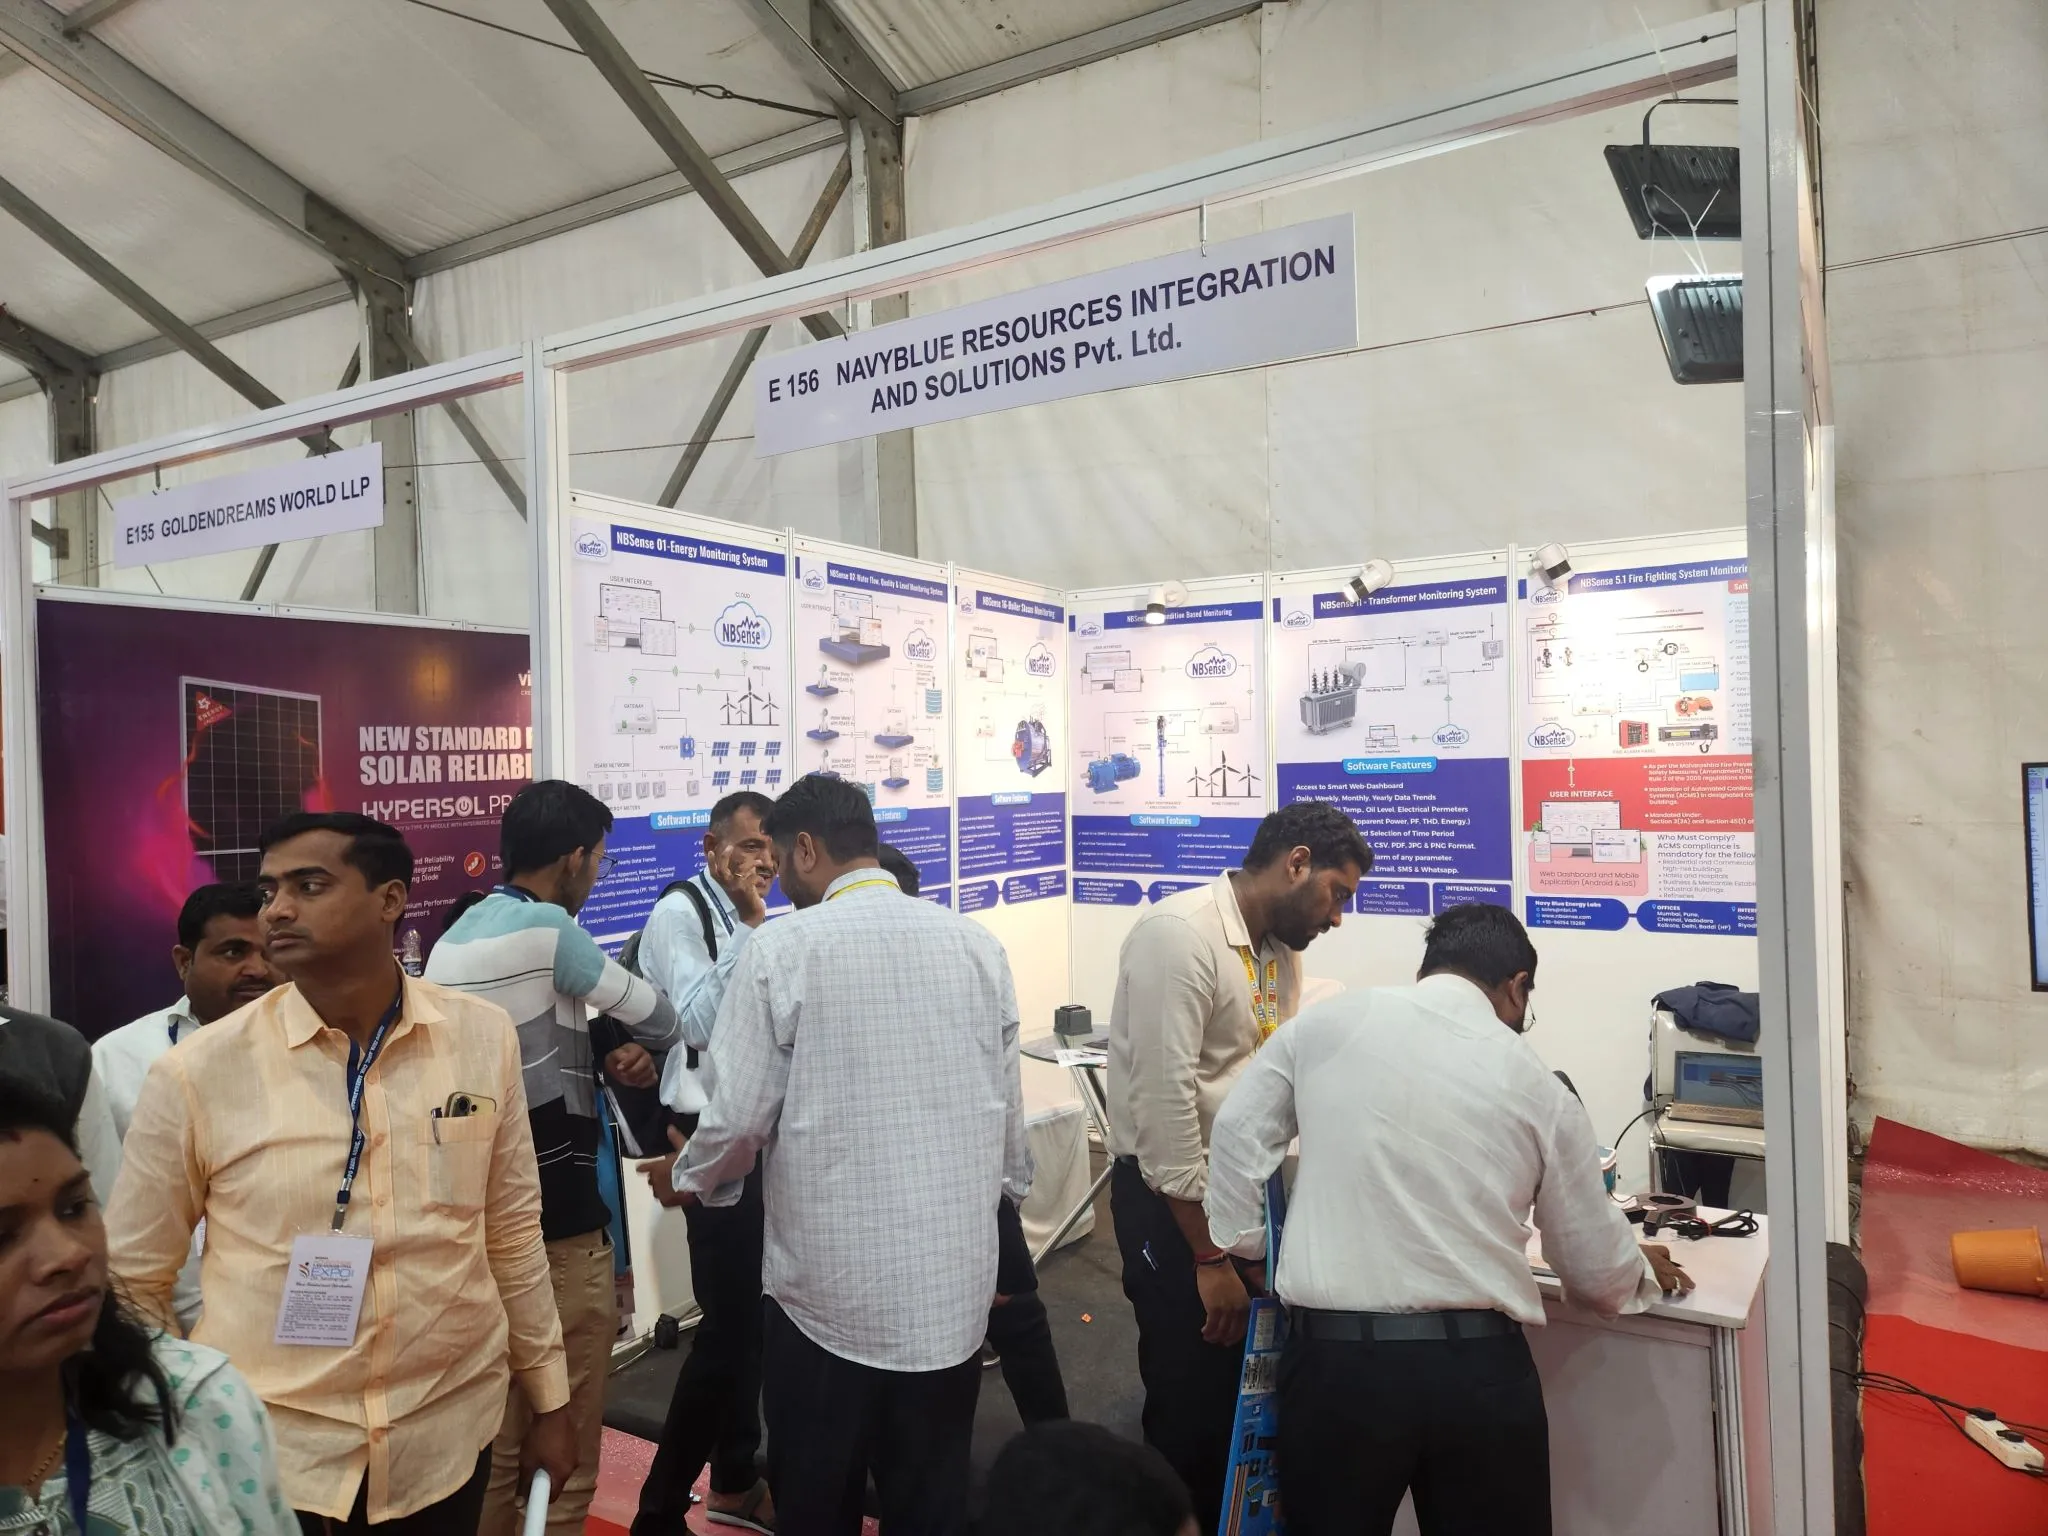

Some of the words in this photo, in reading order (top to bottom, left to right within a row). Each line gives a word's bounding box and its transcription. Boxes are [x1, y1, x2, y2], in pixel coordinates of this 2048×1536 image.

[769, 379, 781, 403] E
[786, 368, 820, 399] 156
[836, 333, 955, 386] NAVYBLUE
[962, 294, 1122, 356] RESOURCES
[1130, 245, 1335, 316] INTEGRATION
[871, 382, 918, 414] AND
[925, 347, 1066, 400] SOLUTIONS
[1074, 339, 1122, 370] Pvt.
[1131, 323, 1182, 358] Ltd.
[127, 523, 154, 545] E155
[161, 497, 275, 537] GOLDENDREAMS
[279, 484, 336, 513] WORLD
[341, 476, 370, 501] LLP
[617, 531, 654, 550] NBSense
[657, 538, 697, 558] 01-Energy
[699, 546, 740, 565] Monitoring
[742, 552, 768, 568] System
[829, 569, 849, 580] NBSense
[880, 578, 895, 589] Quality
[1580, 576, 1614, 589] NBSense
[1615, 575, 1627, 585] 5.1
[1628, 573, 1644, 584] Fire
[1645, 571, 1676, 583] Fighting
[1678, 568, 1709, 580] System
[982, 596, 1001, 608] NBSense
[1320, 600, 1354, 610] NBSense
[1368, 594, 1417, 605] Transformer
[1419, 589, 1464, 603] Monitoring
[1465, 586, 1497, 599] System
[1186, 610, 1202, 619] Based
[1203, 608, 1233, 618] Monitoring
[722, 621, 761, 645] NBSense
[1192, 661, 1226, 676] NBSense
[359, 726, 410, 751] NEW
[415, 726, 522, 751] STANDARD
[1437, 734, 1462, 743] NBSense
[1534, 735, 1566, 746] NBSense
[359, 755, 442, 786] SOLAR
[1347, 762, 1388, 771] Software
[1391, 760, 1432, 770] Features
[1349, 782, 1404, 790] Web-Dashboard
[1372, 794, 1393, 802] Yearly
[362, 796, 485, 821] HYPERSOL
[489, 795, 512, 814] PR
[657, 813, 690, 827] Software
[1139, 816, 1165, 825] Software
[1165, 816, 1192, 825] Features
[1698, 834, 1736, 843] Comply?
[1682, 843, 1732, 851] compliance
[424, 855, 455, 865] Reliability
[1657, 851, 1703, 860] mandatory
[413, 865, 441, 874] tegrated
[1421, 866, 1459, 875] Whatsapp.
[1581, 879, 1613, 887] (Android
[1445, 885, 1498, 894] INTERNATIONAL
[423, 898, 456, 907] Performan
[403, 909, 430, 918] ameters
